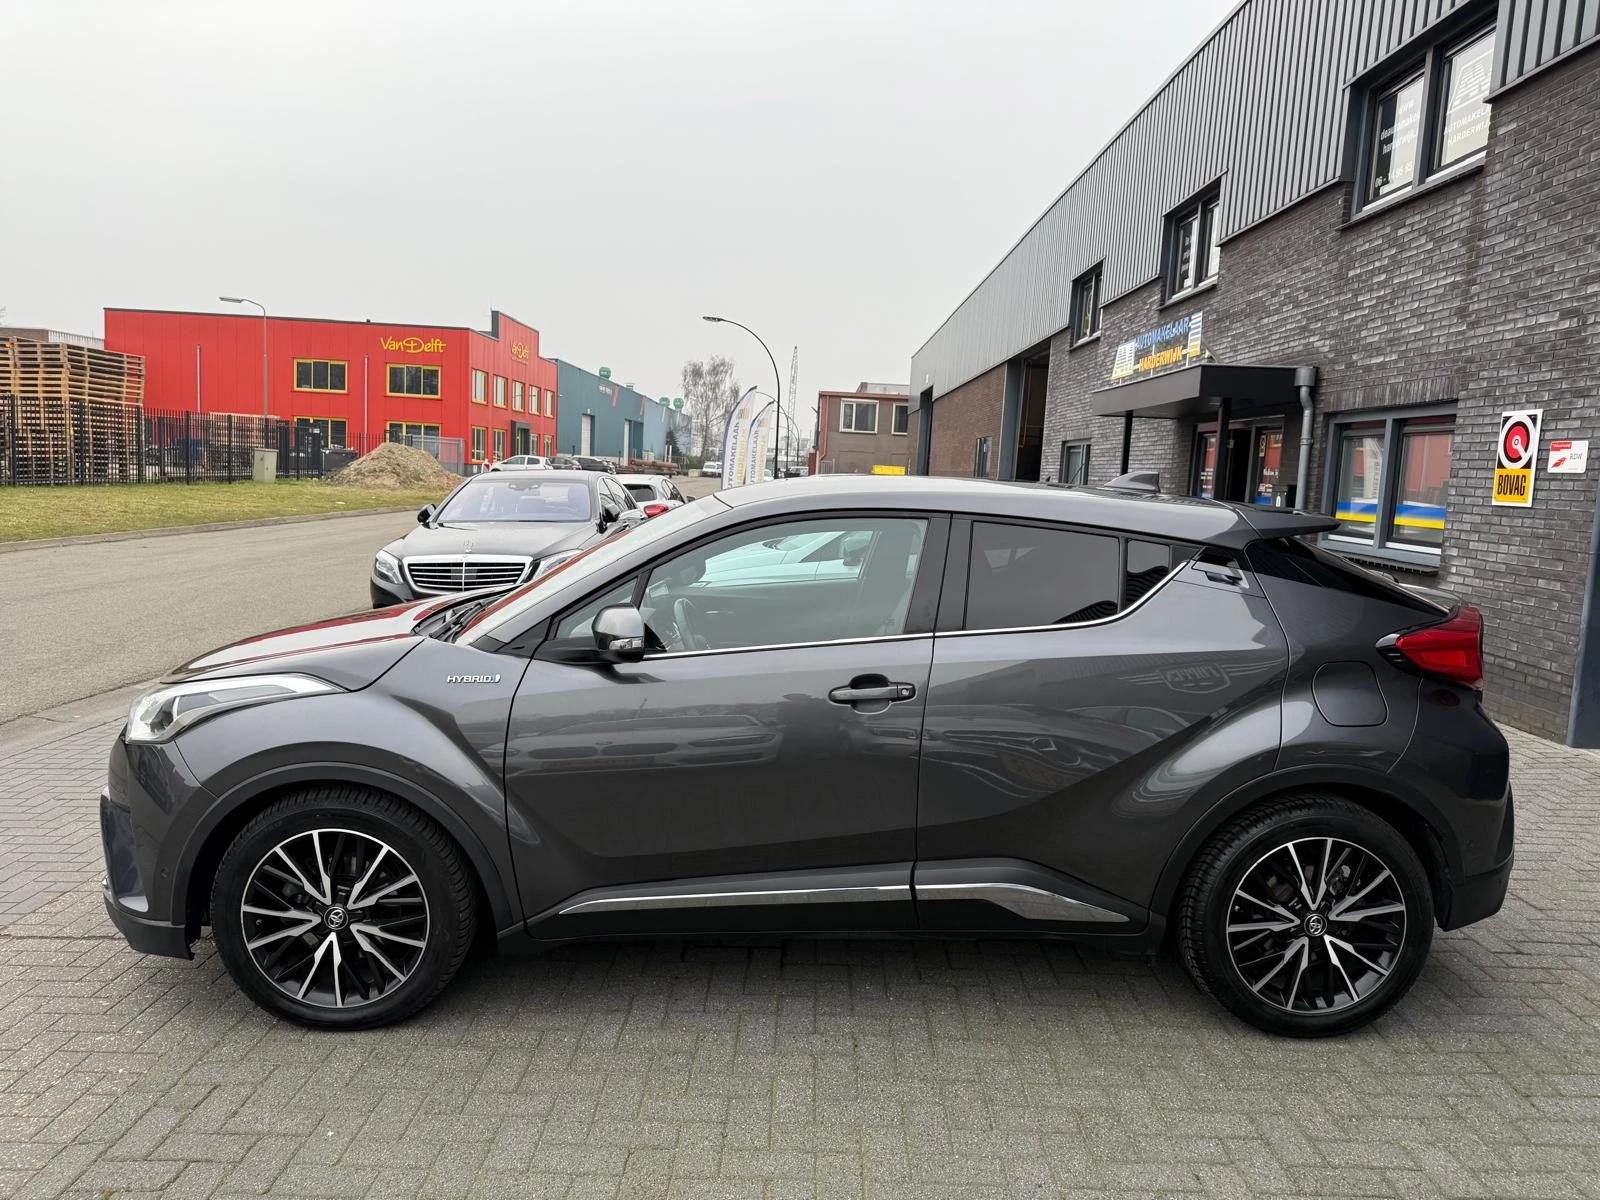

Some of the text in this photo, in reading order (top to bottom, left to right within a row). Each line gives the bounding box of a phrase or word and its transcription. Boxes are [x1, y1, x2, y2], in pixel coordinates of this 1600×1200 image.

[1134, 317, 1190, 350] AUTOMAKELAAR
[1138, 345, 1183, 372] HARDERWIJK
[727, 422, 740, 488] UTOMAKELAAR
[1497, 474, 1526, 496] BOVAG
[446, 675, 491, 683] HYBRID
